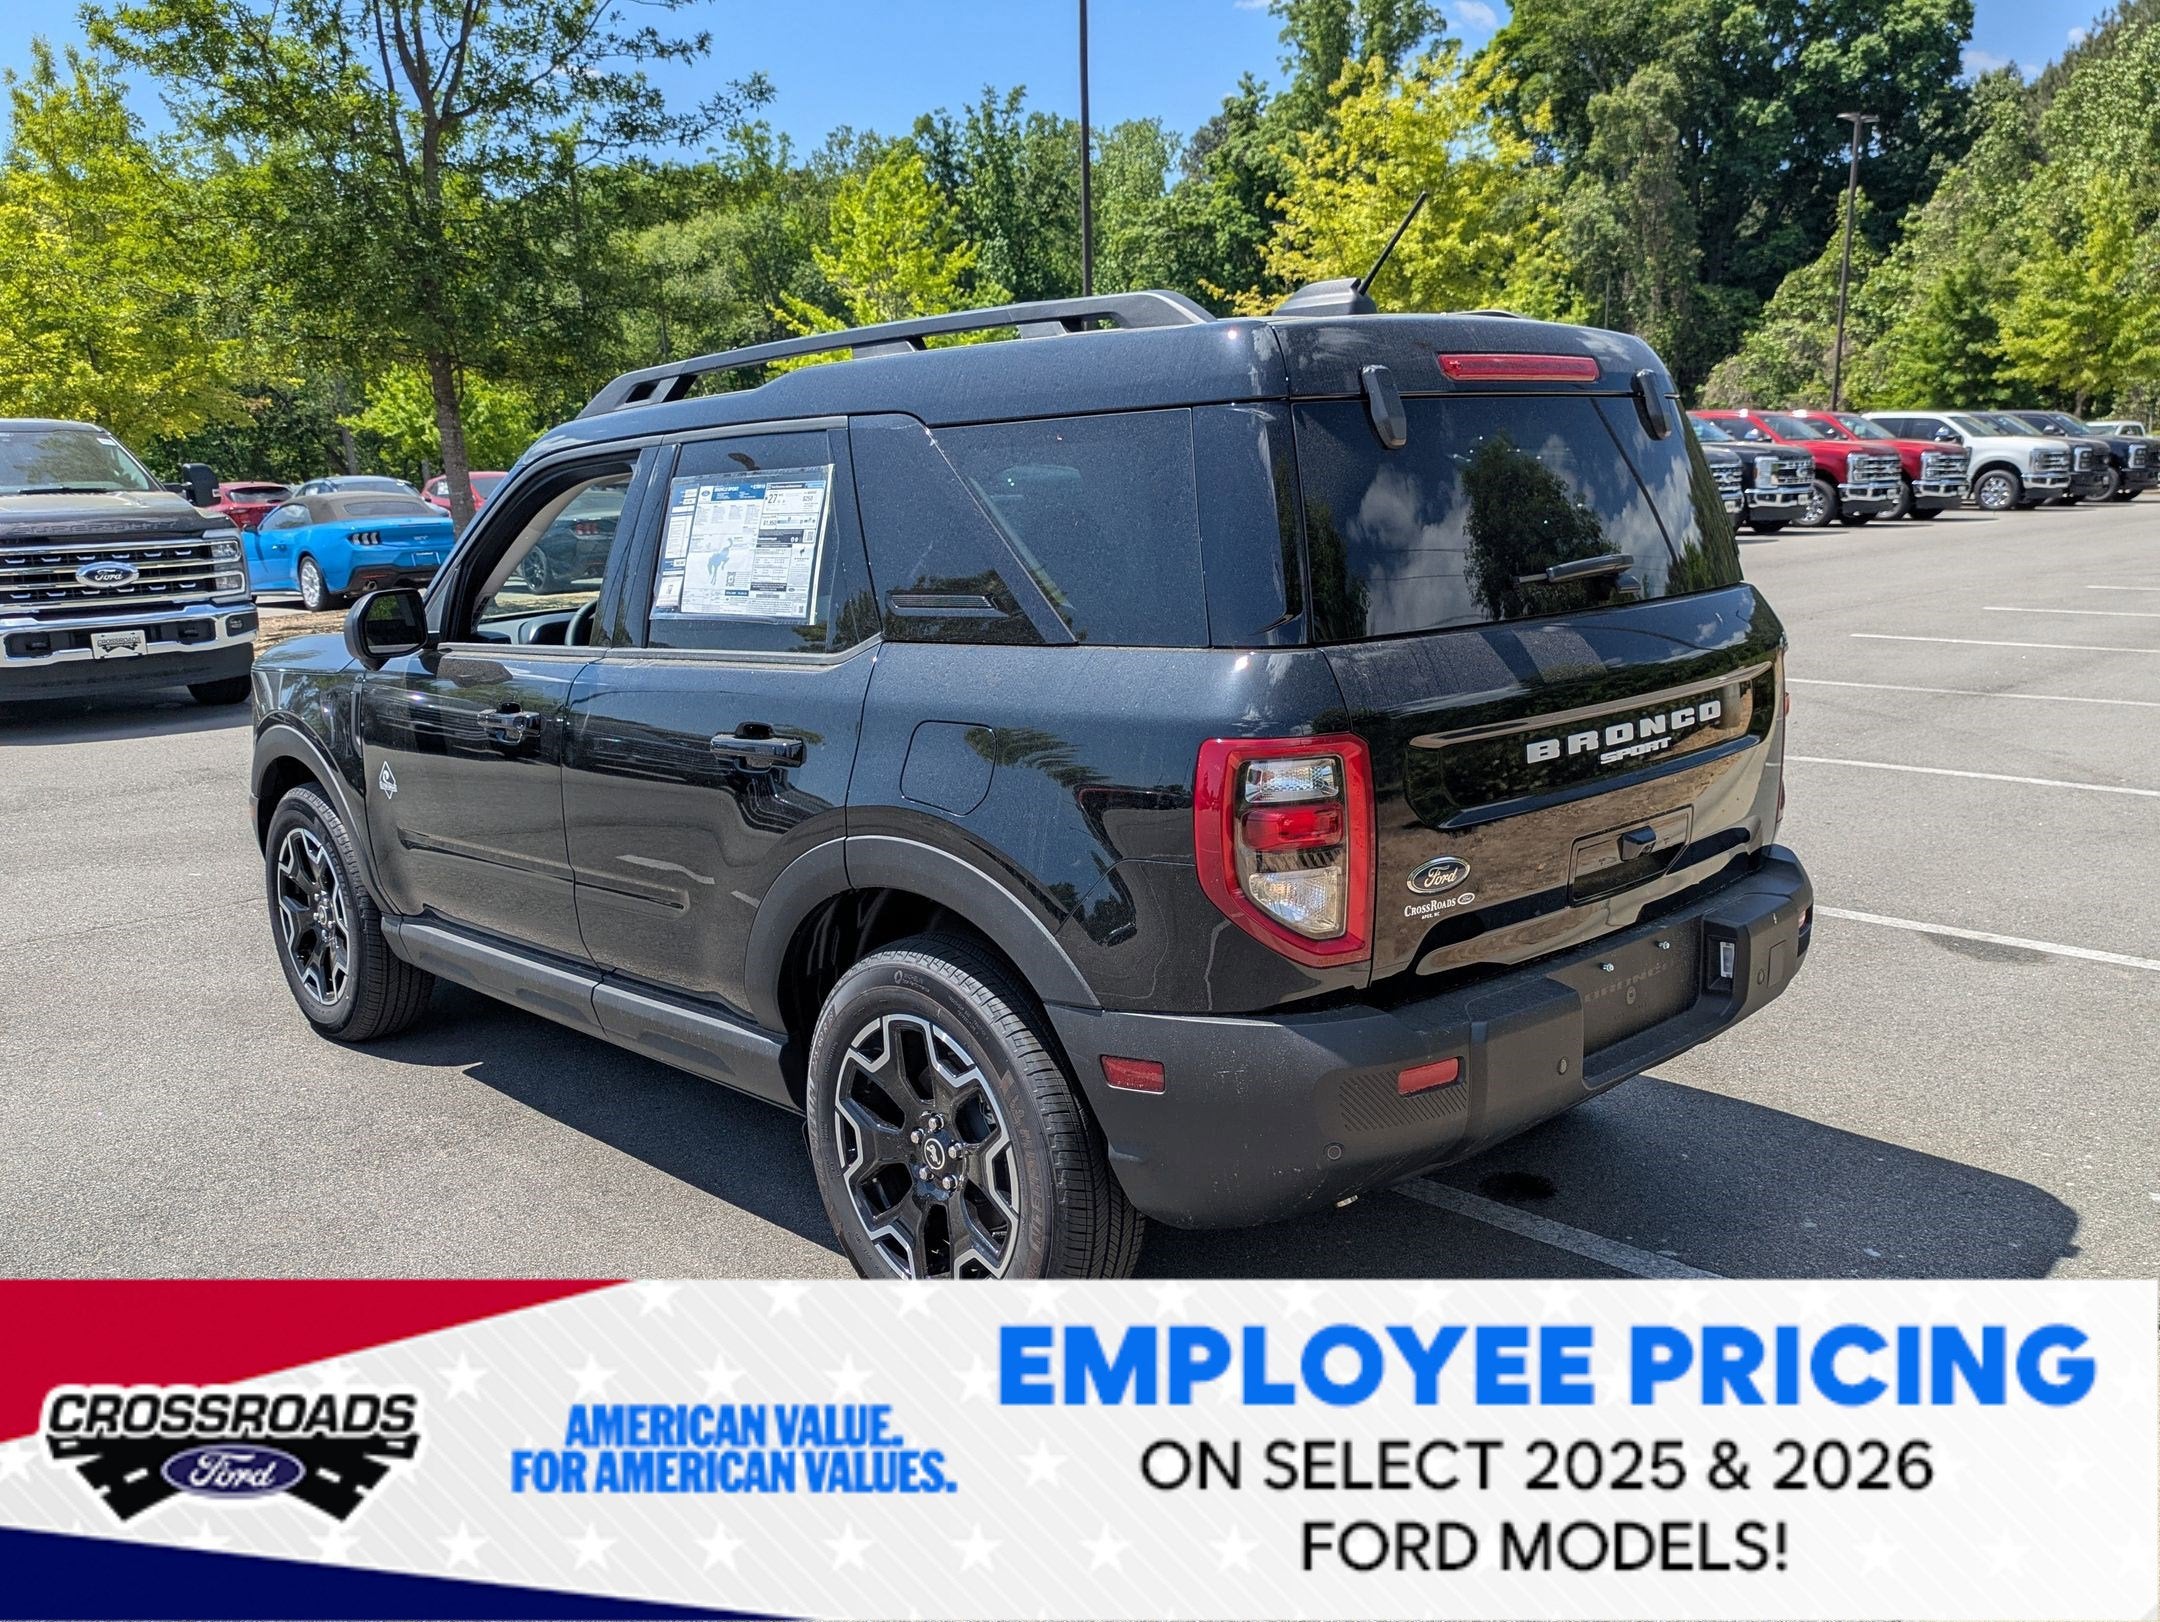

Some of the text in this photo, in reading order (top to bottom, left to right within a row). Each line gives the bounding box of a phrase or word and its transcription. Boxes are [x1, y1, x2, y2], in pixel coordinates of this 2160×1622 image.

[94, 569, 123, 581] Ford
[1526, 700, 1722, 765] BRONCO
[1600, 736, 1672, 765] SPORT
[1424, 865, 1458, 888] Ford
